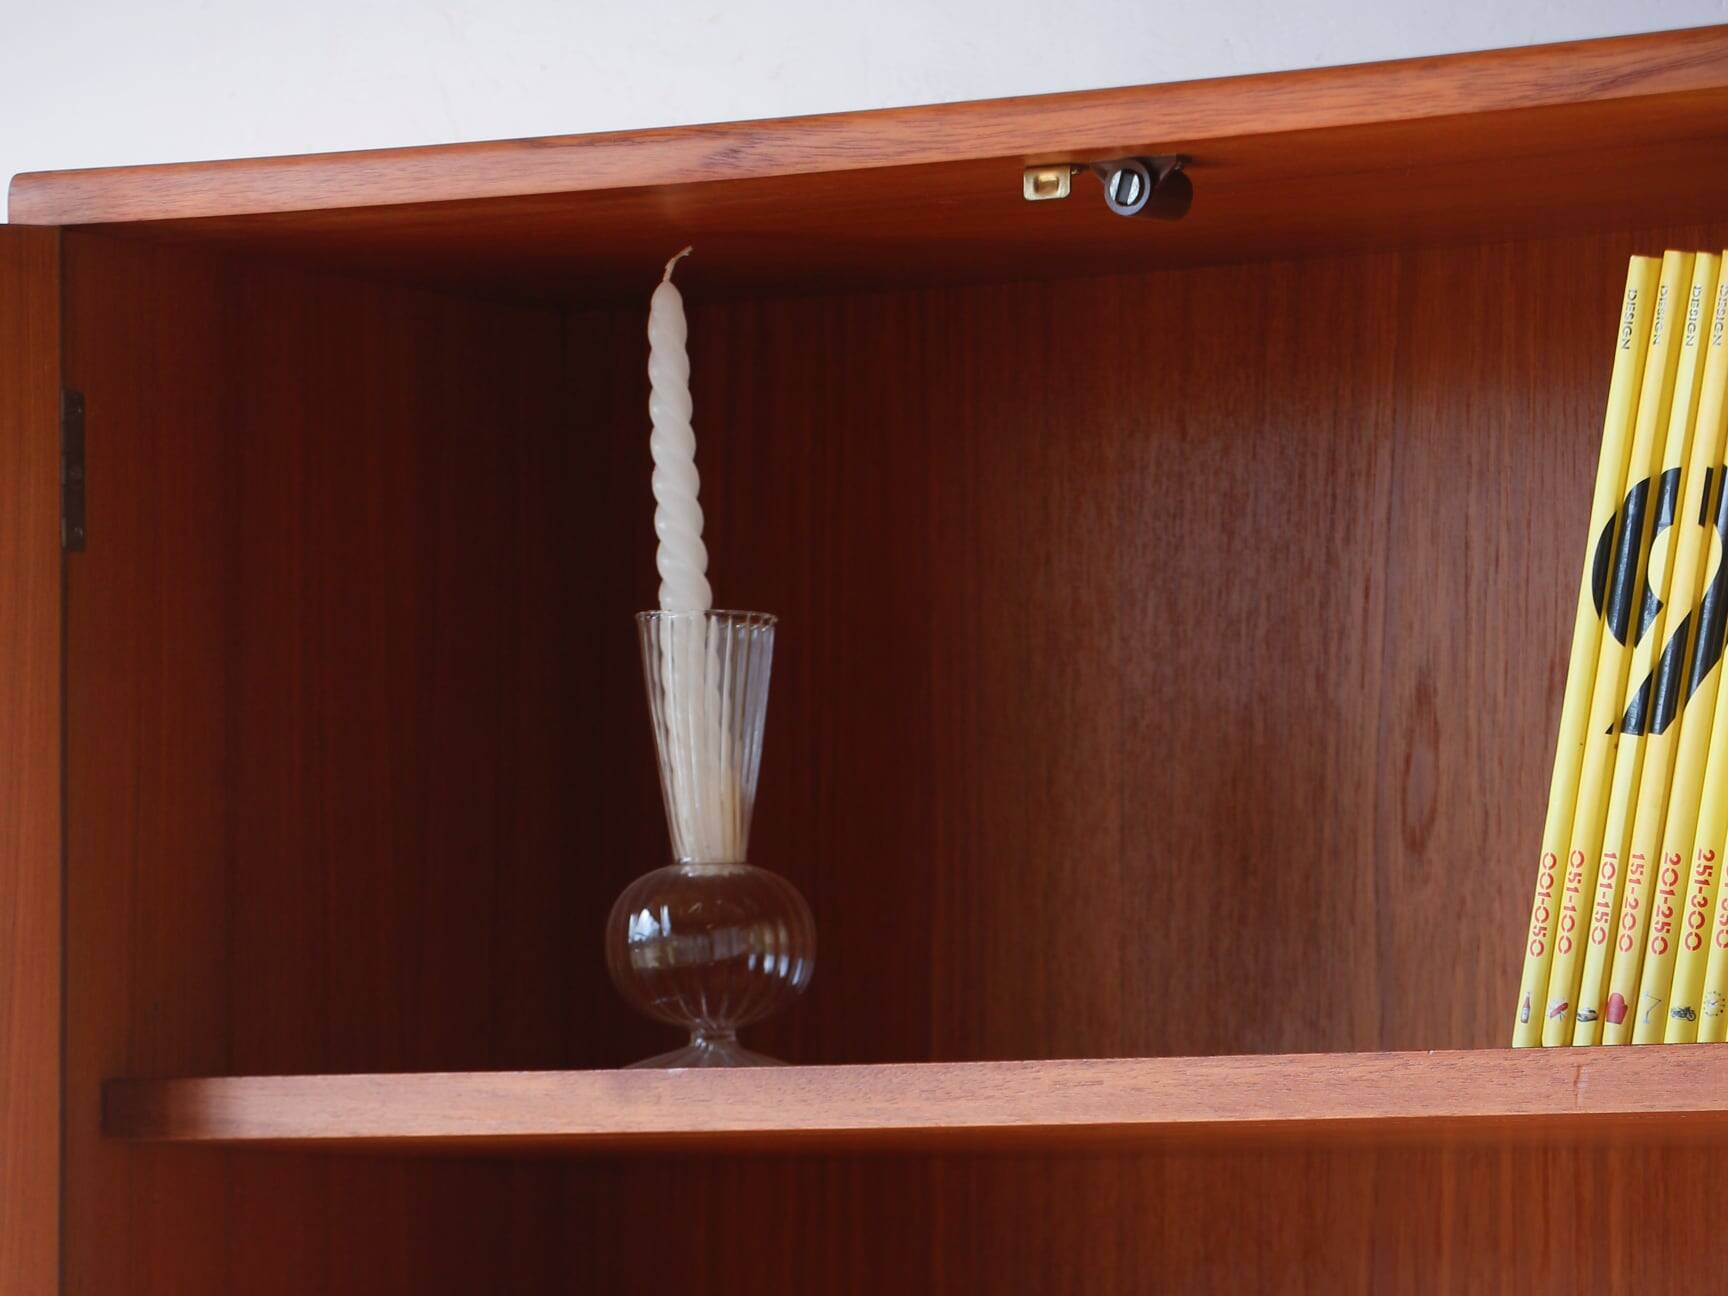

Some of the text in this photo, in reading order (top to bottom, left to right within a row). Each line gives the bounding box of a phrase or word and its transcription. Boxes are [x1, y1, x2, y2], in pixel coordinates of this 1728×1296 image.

[1621, 288, 1638, 350] DESIGN
[1686, 284, 1702, 347] DESIGN
[1529, 852, 1557, 958] 001-050
[1557, 849, 1585, 955] 051-100
[1591, 852, 1618, 945] 101-150
[1618, 853, 1646, 953] 151-200
[1651, 852, 1682, 956] 201-250
[1684, 848, 1716, 952] 251-300
